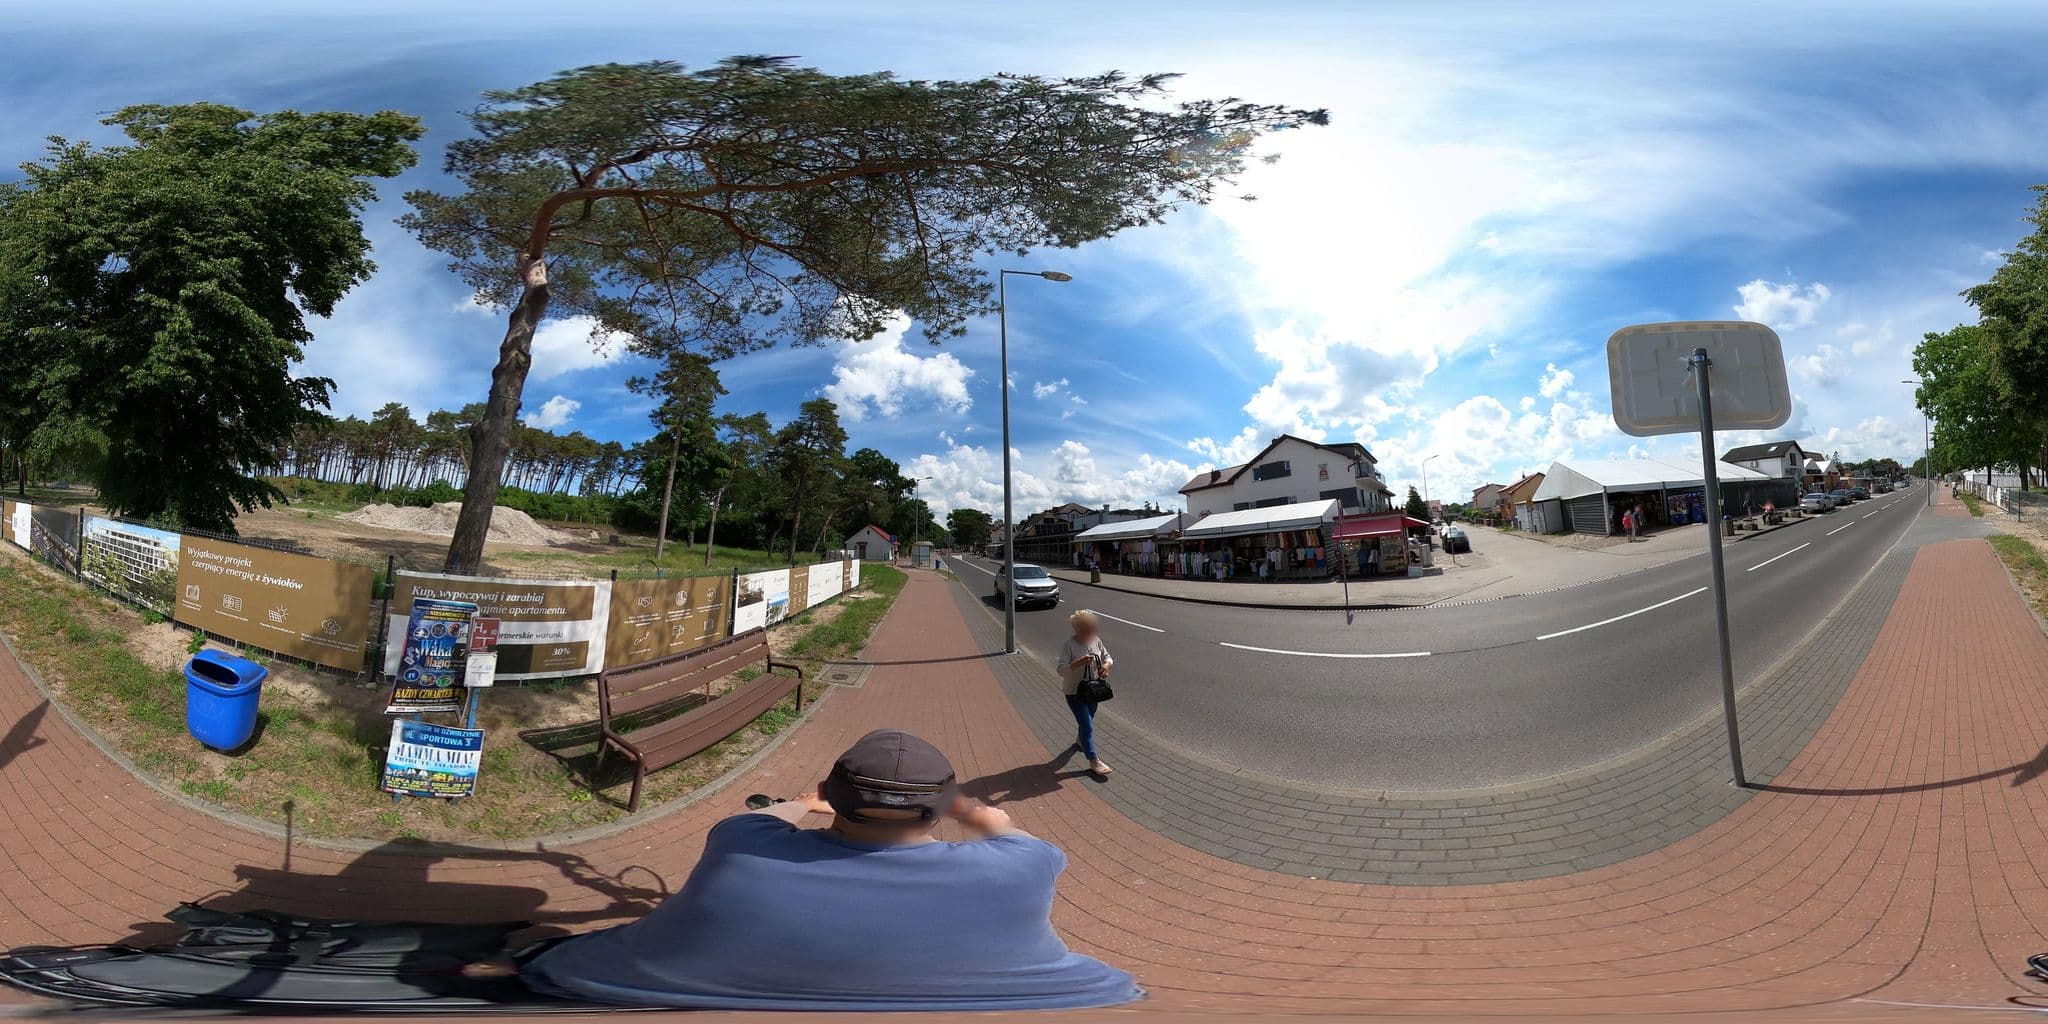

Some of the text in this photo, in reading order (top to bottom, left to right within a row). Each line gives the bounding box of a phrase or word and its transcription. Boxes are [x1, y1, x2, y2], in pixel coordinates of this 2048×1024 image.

[224, 556, 252, 568] projekt
[191, 560, 225, 574] czerpiący
[225, 568, 255, 582] energię
[261, 573, 303, 591] żywiołów
[411, 585, 436, 599] Kup,
[439, 591, 499, 603] wypoczywaj
[505, 592, 545, 604] zarabiaj
[479, 604, 508, 615] ajmie
[509, 607, 567, 617] apartamentu.
[552, 647, 571, 656] 30%
